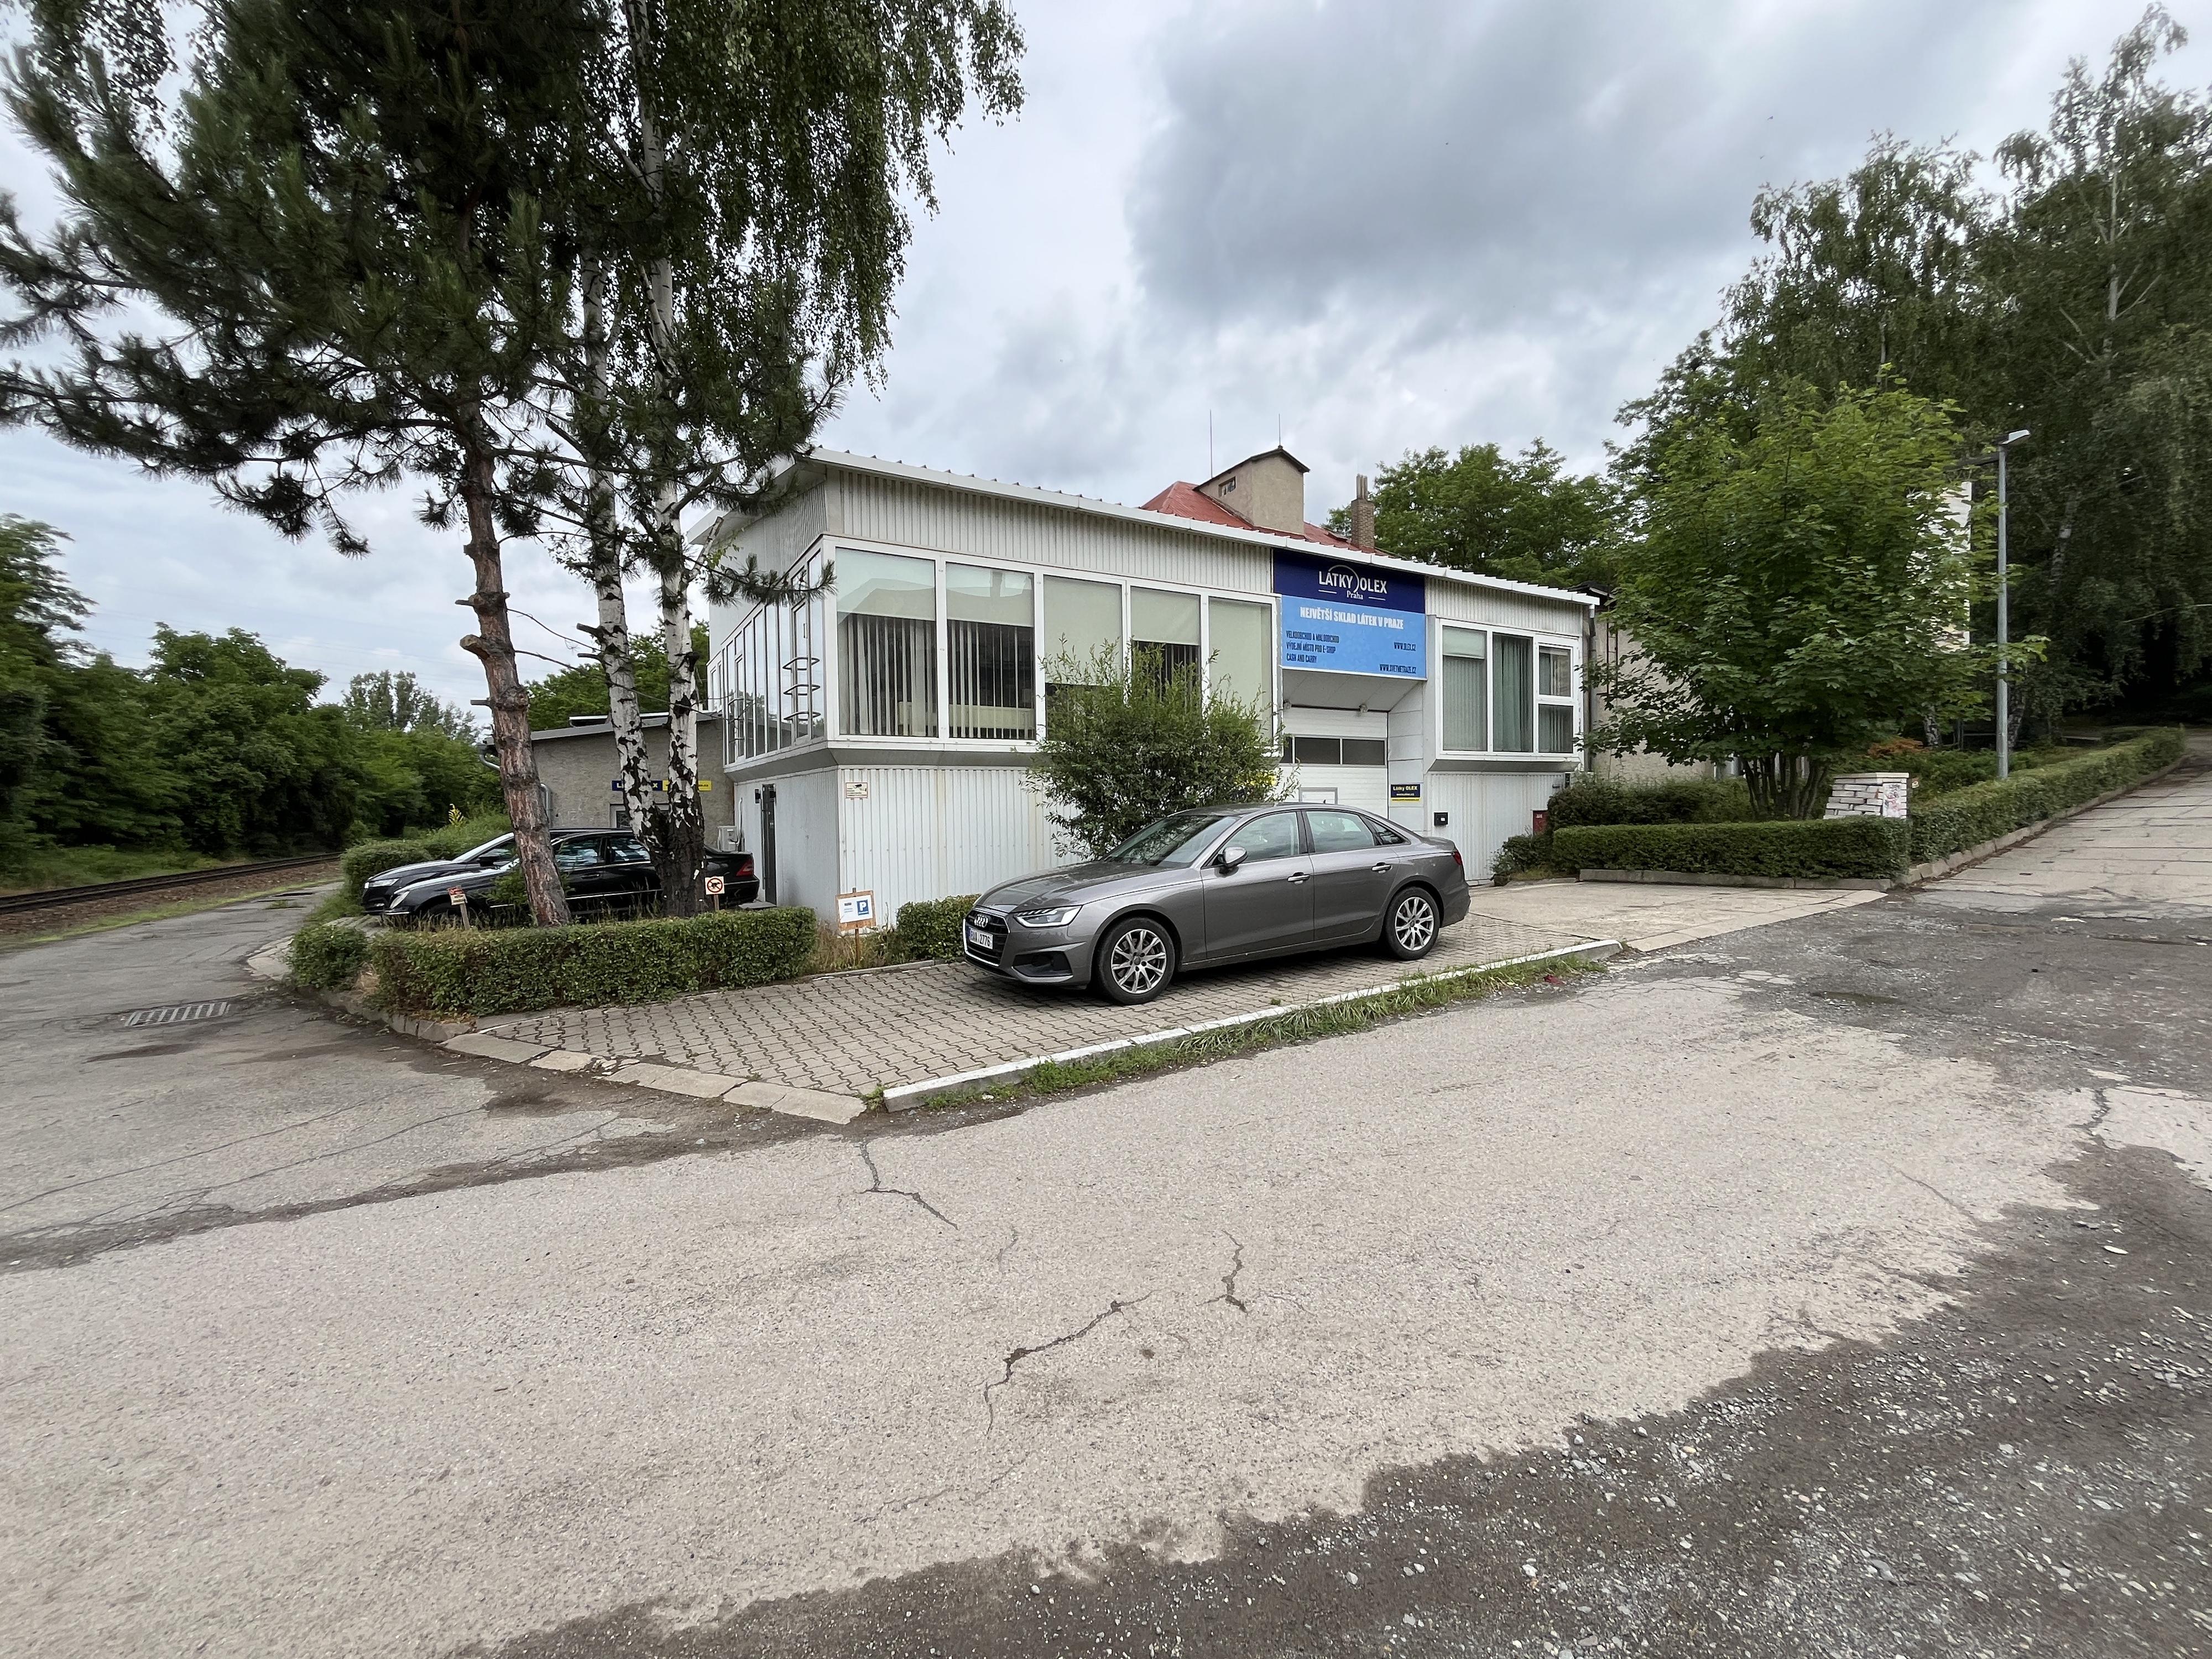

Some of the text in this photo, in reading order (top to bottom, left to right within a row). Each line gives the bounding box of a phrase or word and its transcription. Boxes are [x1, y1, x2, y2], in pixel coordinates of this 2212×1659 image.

[1360, 577, 1387, 594] OLEX
[1346, 590, 1364, 600] Praha
[1333, 611, 1356, 624] SKLAD
[1357, 612, 1378, 626] LÁTEK
[1378, 617, 1383, 628] V
[1384, 617, 1404, 630] PRAZE
[859, 901, 867, 911] P
